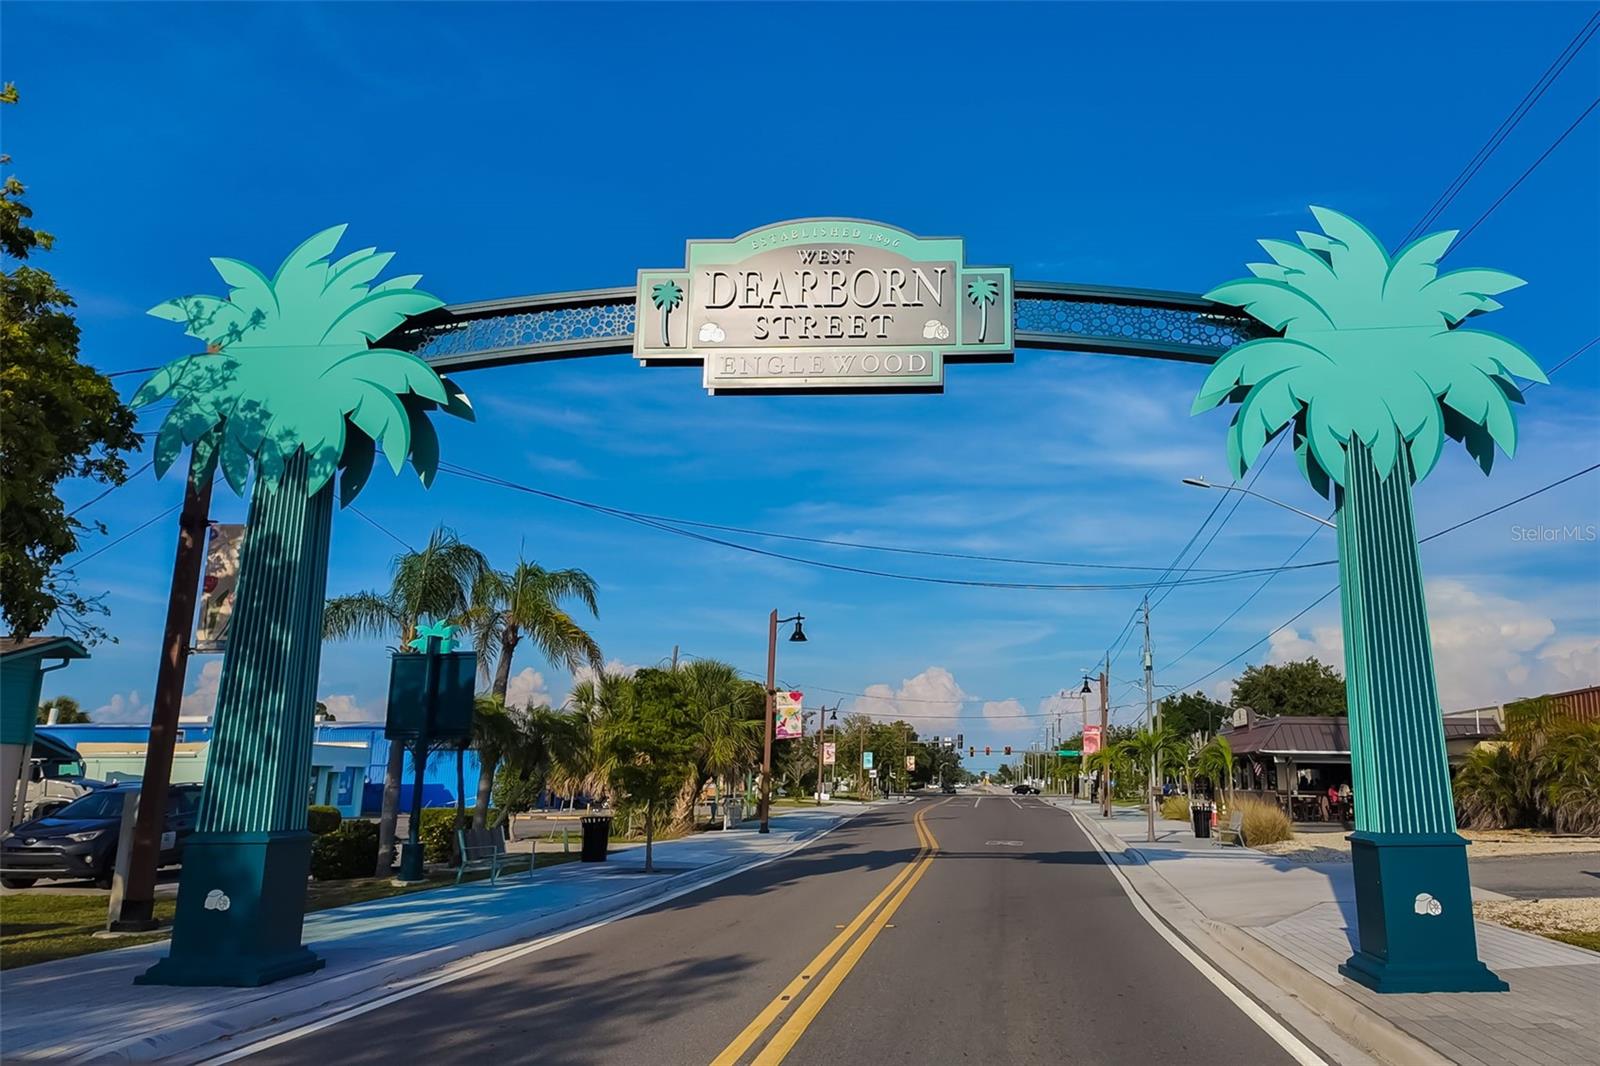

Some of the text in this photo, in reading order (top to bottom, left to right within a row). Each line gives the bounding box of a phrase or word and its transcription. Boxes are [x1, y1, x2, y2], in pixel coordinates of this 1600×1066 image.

[751, 226, 901, 250] ESTABLISHED 1896
[797, 249, 855, 265] WEST
[704, 267, 948, 309] DEARBORN
[753, 313, 895, 340] STREET
[719, 353, 928, 375] ENGLEWOOD
